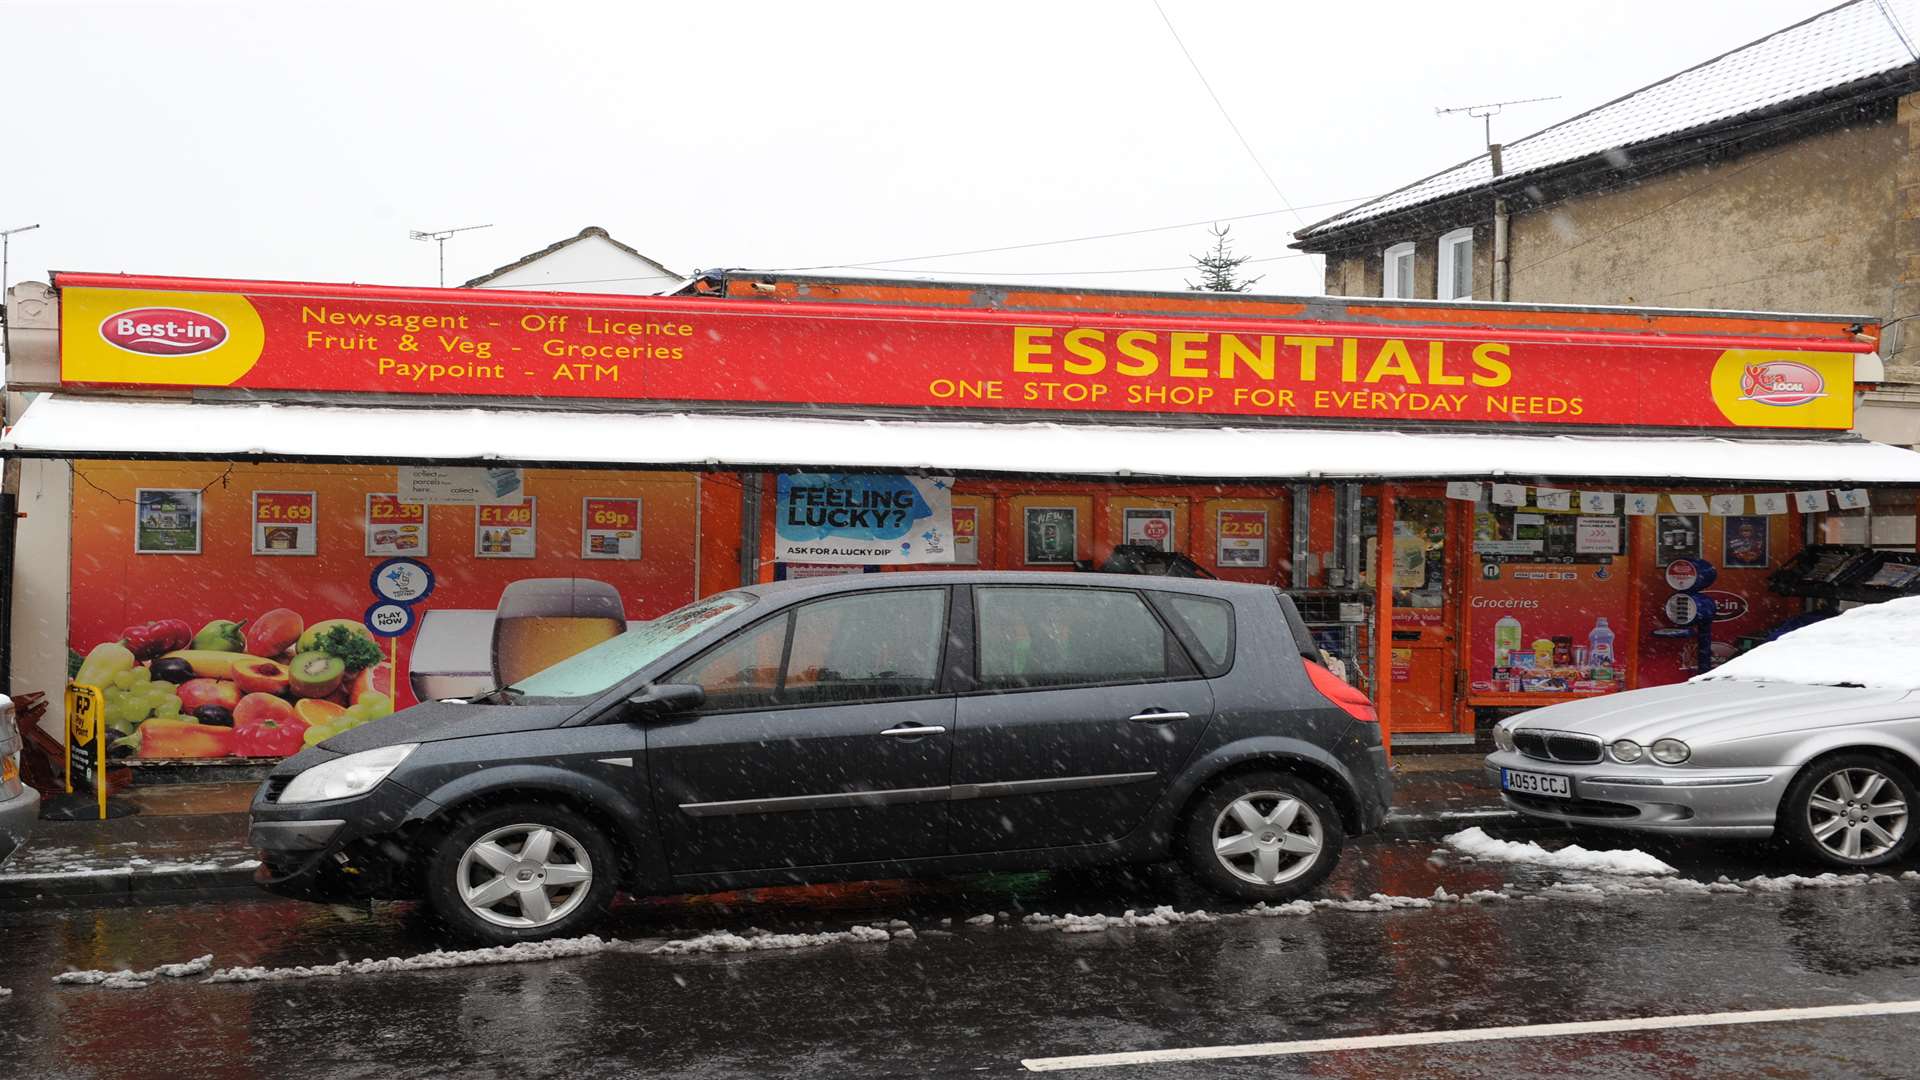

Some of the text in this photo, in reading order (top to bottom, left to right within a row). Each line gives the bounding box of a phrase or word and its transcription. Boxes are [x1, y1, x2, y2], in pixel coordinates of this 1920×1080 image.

[116, 317, 212, 341] Best-in
[301, 305, 469, 333] Newsagent
[520, 313, 569, 334] Off
[587, 316, 693, 338] Licence
[306, 329, 378, 352] Fruit
[394, 332, 419, 354] &
[438, 334, 492, 360] Veg
[543, 338, 684, 362] Groceries
[1012, 325, 1512, 388] ESSENTIALS
[378, 357, 505, 382] Paypoint
[552, 363, 620, 382] ATM
[1772, 382, 1804, 392] LOCAL
[929, 378, 1584, 416] ONE STOP SHOP FOR EVERYDAY NEEDS
[789, 486, 914, 508] FEELING
[257, 505, 312, 520] £1.69
[372, 504, 423, 519] £2.39
[594, 510, 630, 528] 69p
[788, 507, 907, 529] LUCKY?
[1221, 522, 1263, 535] £2.50
[787, 547, 808, 555] ASK
[810, 547, 830, 556] FOR
[831, 548, 839, 556] A
[840, 548, 873, 556] LUCKY
[1471, 595, 1539, 609] Groceries
[377, 611, 401, 620] PLAY
[378, 618, 402, 626] NOW
[1510, 773, 1568, 794] AO53 CCJ
